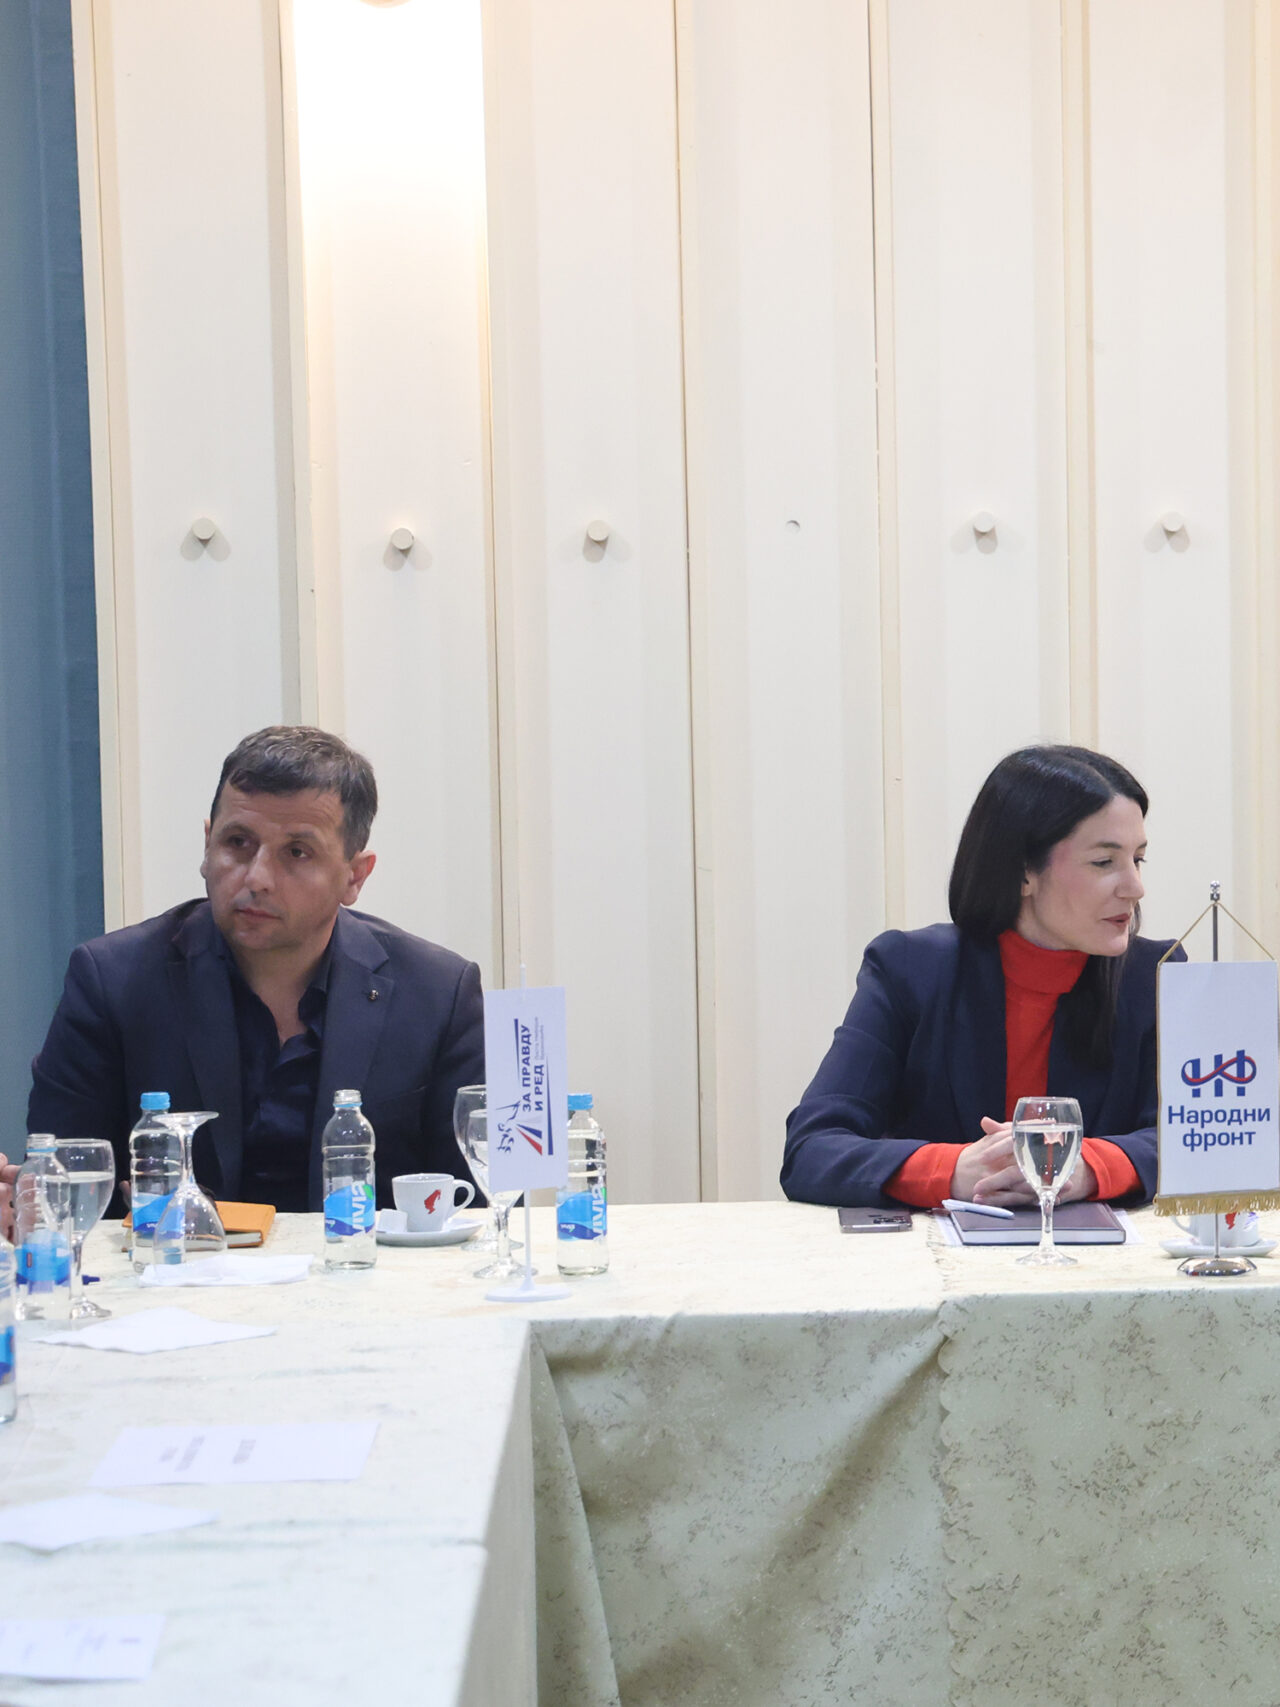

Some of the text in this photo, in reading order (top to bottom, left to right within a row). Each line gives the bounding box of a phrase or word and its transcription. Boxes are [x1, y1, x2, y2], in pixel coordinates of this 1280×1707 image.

[521, 1024, 533, 1112] ЗА ПРАВДУ
[534, 1064, 545, 1099] РЕД
[534, 1101, 544, 1112] И
[1168, 1105, 1271, 1129] Народни
[1182, 1128, 1257, 1152] фронт
